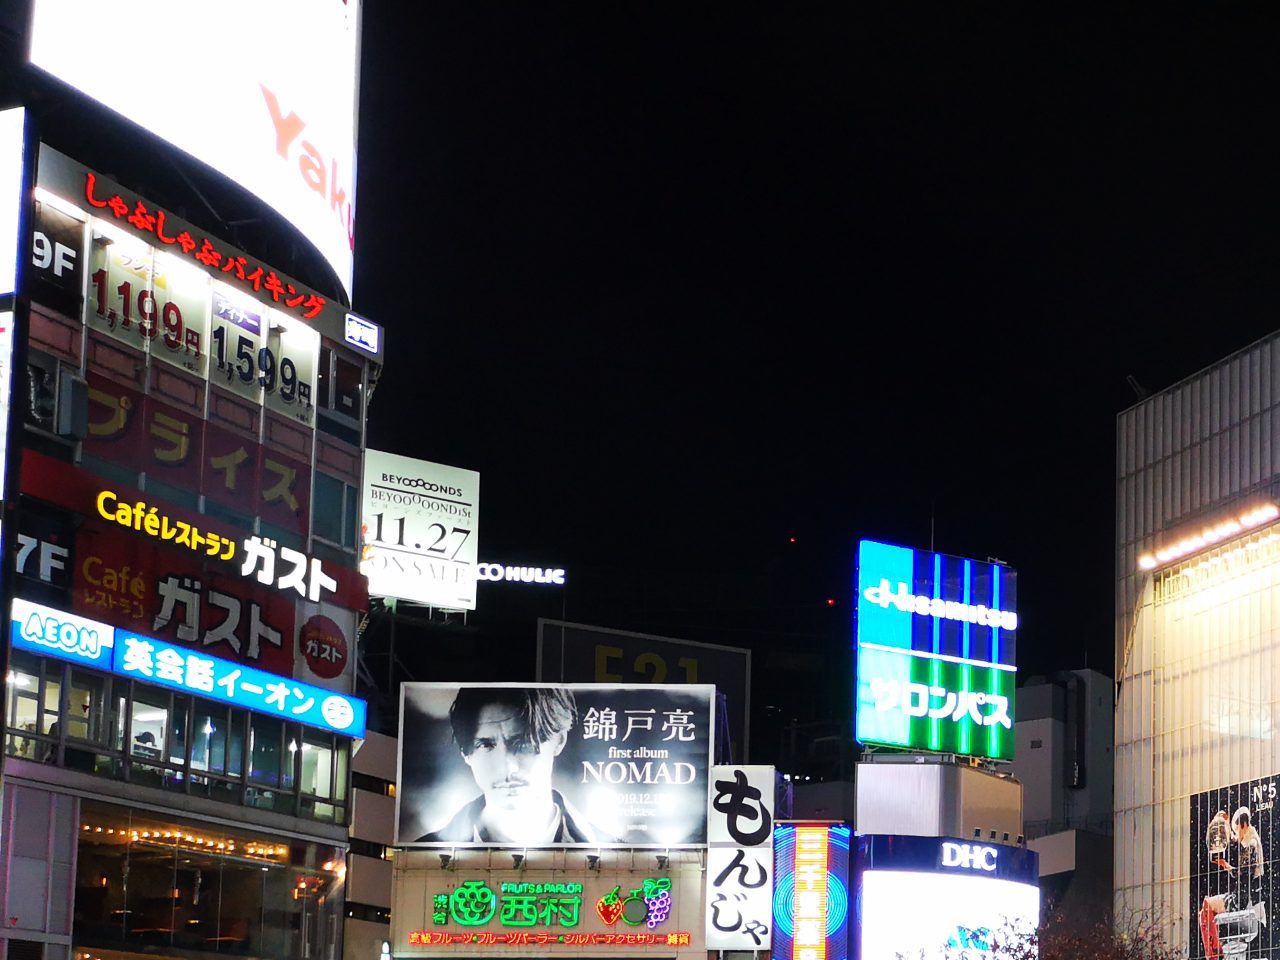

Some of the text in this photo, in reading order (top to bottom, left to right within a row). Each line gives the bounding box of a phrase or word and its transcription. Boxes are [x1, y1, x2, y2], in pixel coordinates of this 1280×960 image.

[33, 231, 77, 278] 9F
[85, 172, 327, 320] しゃぶしゃぶバイキング
[92, 268, 201, 359] 1,199円
[217, 300, 260, 327] ディナー
[212, 325, 312, 409] 1,599円
[15, 534, 69, 582] 7F
[371, 512, 471, 560] 11.27
[82, 556, 147, 600] Café
[241, 535, 337, 602] ガスト
[505, 566, 565, 585] HULIC
[20, 612, 102, 660] AEON
[154, 575, 282, 660] ガスト
[306, 640, 343, 663] ガスト
[123, 637, 315, 715] 英会話イーオン
[583, 707, 696, 743] 錦戸亮
[870, 678, 1012, 729] サロンパス
[581, 761, 696, 785] NOMAD
[608, 746, 669, 759] first album
[713, 769, 772, 946] もんじゃ
[942, 842, 998, 872] DHC
[433, 893, 448, 925] 渋谷
[500, 895, 581, 927] 西村
